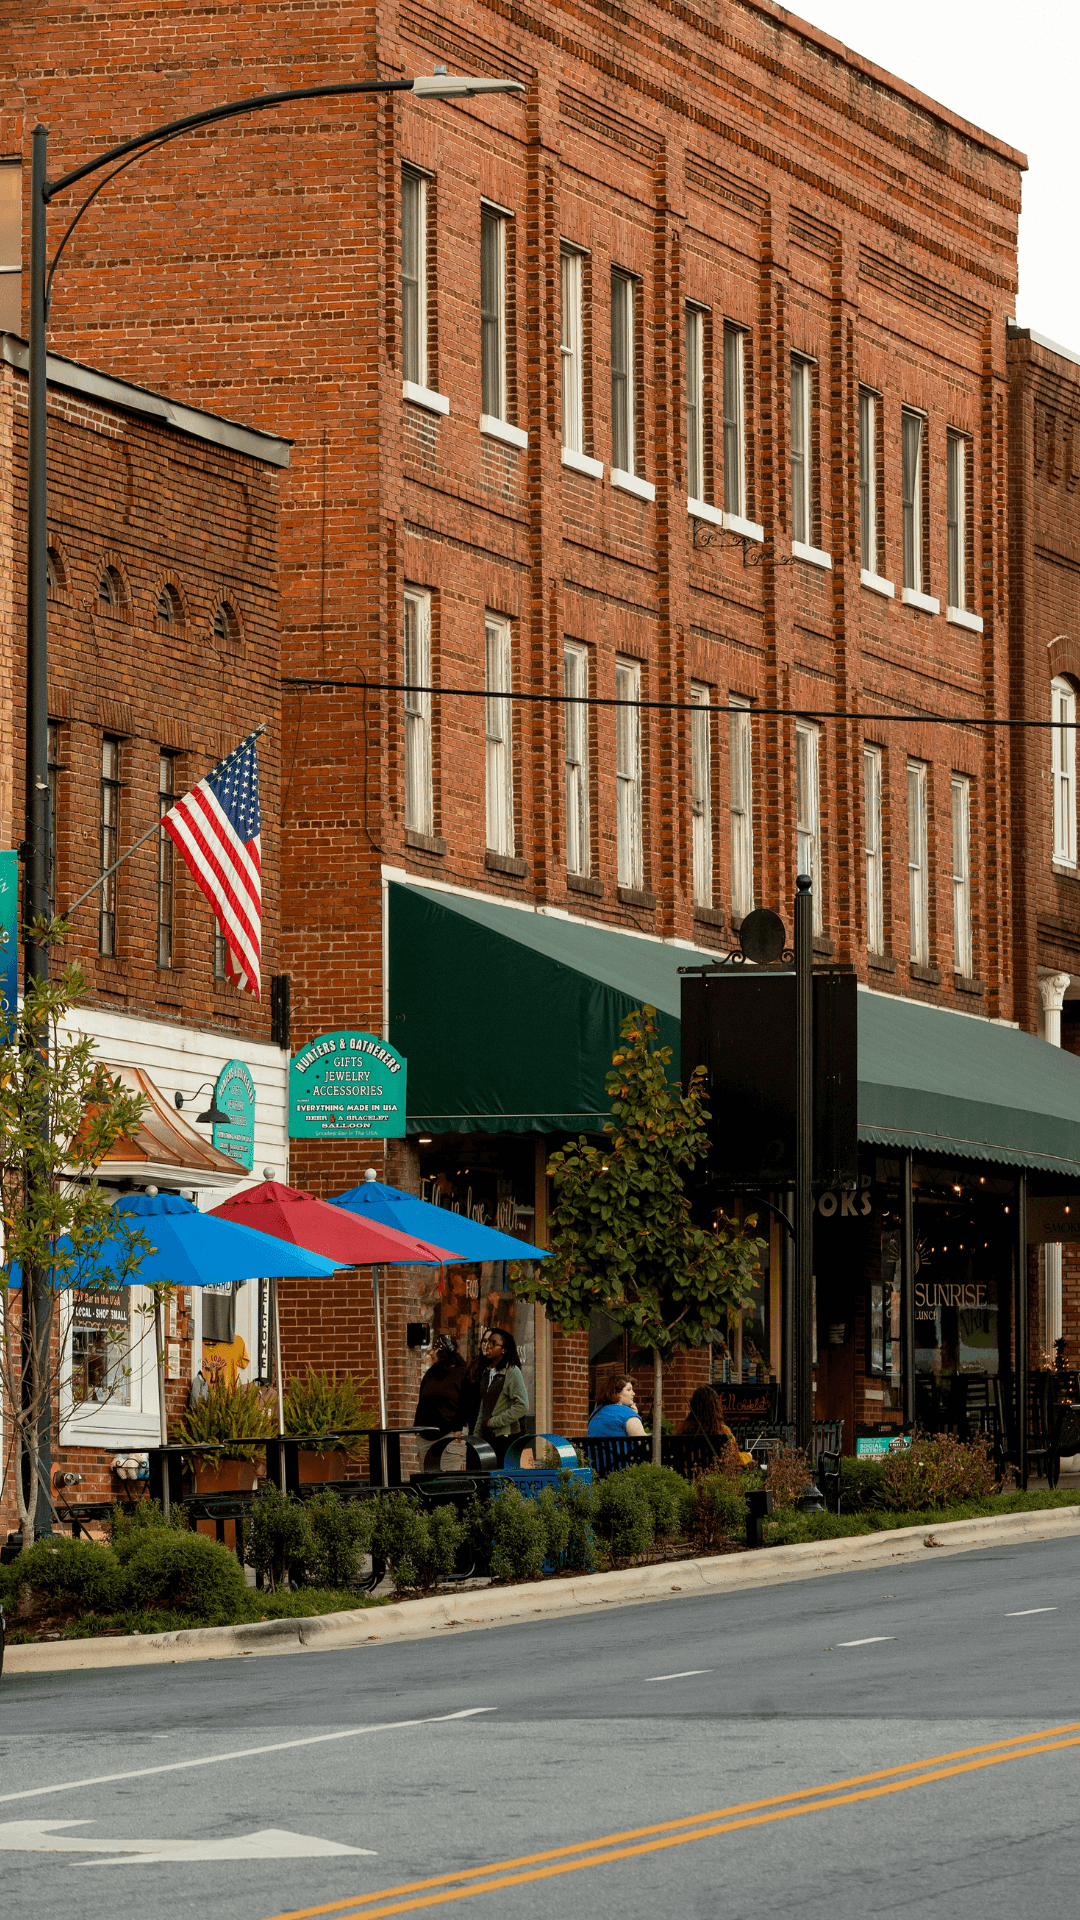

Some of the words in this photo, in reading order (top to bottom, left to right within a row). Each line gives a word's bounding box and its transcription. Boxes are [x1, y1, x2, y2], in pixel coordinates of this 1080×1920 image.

[295, 1040, 336, 1073] HUNTERS
[340, 1038, 346, 1050] &
[349, 1038, 401, 1073] GATHERERS
[333, 1056, 363, 1067] GIFTS
[324, 1071, 370, 1083] JEWELRY
[312, 1085, 383, 1096] ACCESSORIES
[296, 1104, 344, 1112] EVERYTHING
[100, 1294, 109, 1305] the
[915, 1282, 988, 1307] SUNRISE
[914, 1310, 939, 1320] LUNCH
